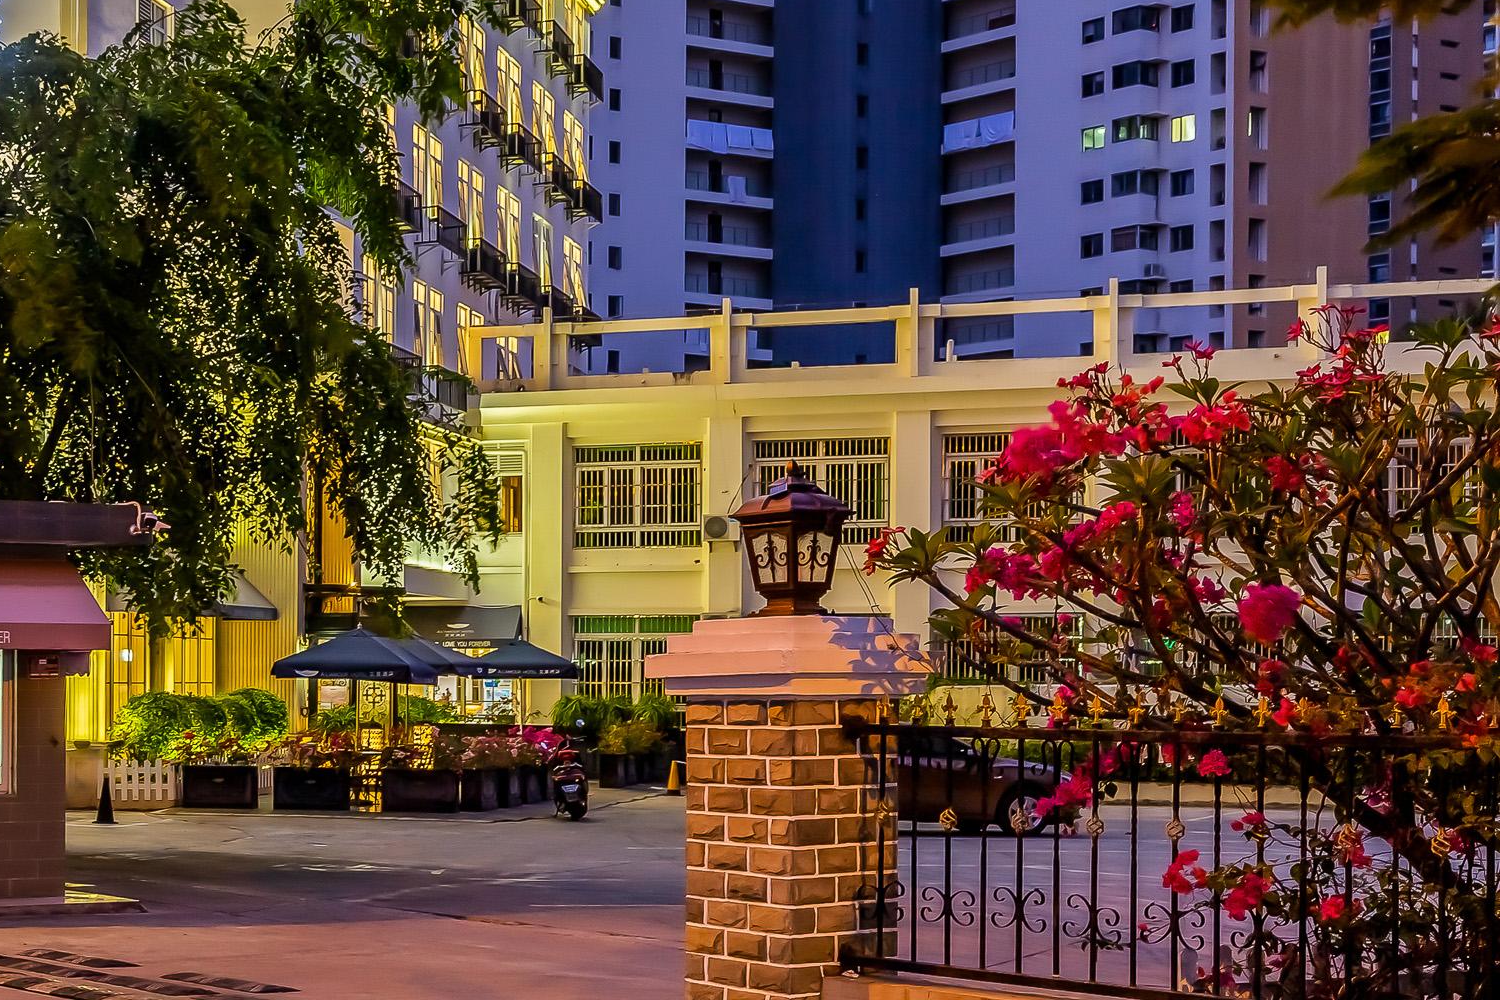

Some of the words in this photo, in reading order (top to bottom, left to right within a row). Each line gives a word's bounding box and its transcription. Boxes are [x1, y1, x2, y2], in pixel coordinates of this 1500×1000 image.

[442, 640, 455, 648] LOVE
[456, 640, 468, 648] YOU
[468, 640, 491, 648] FOREVER
